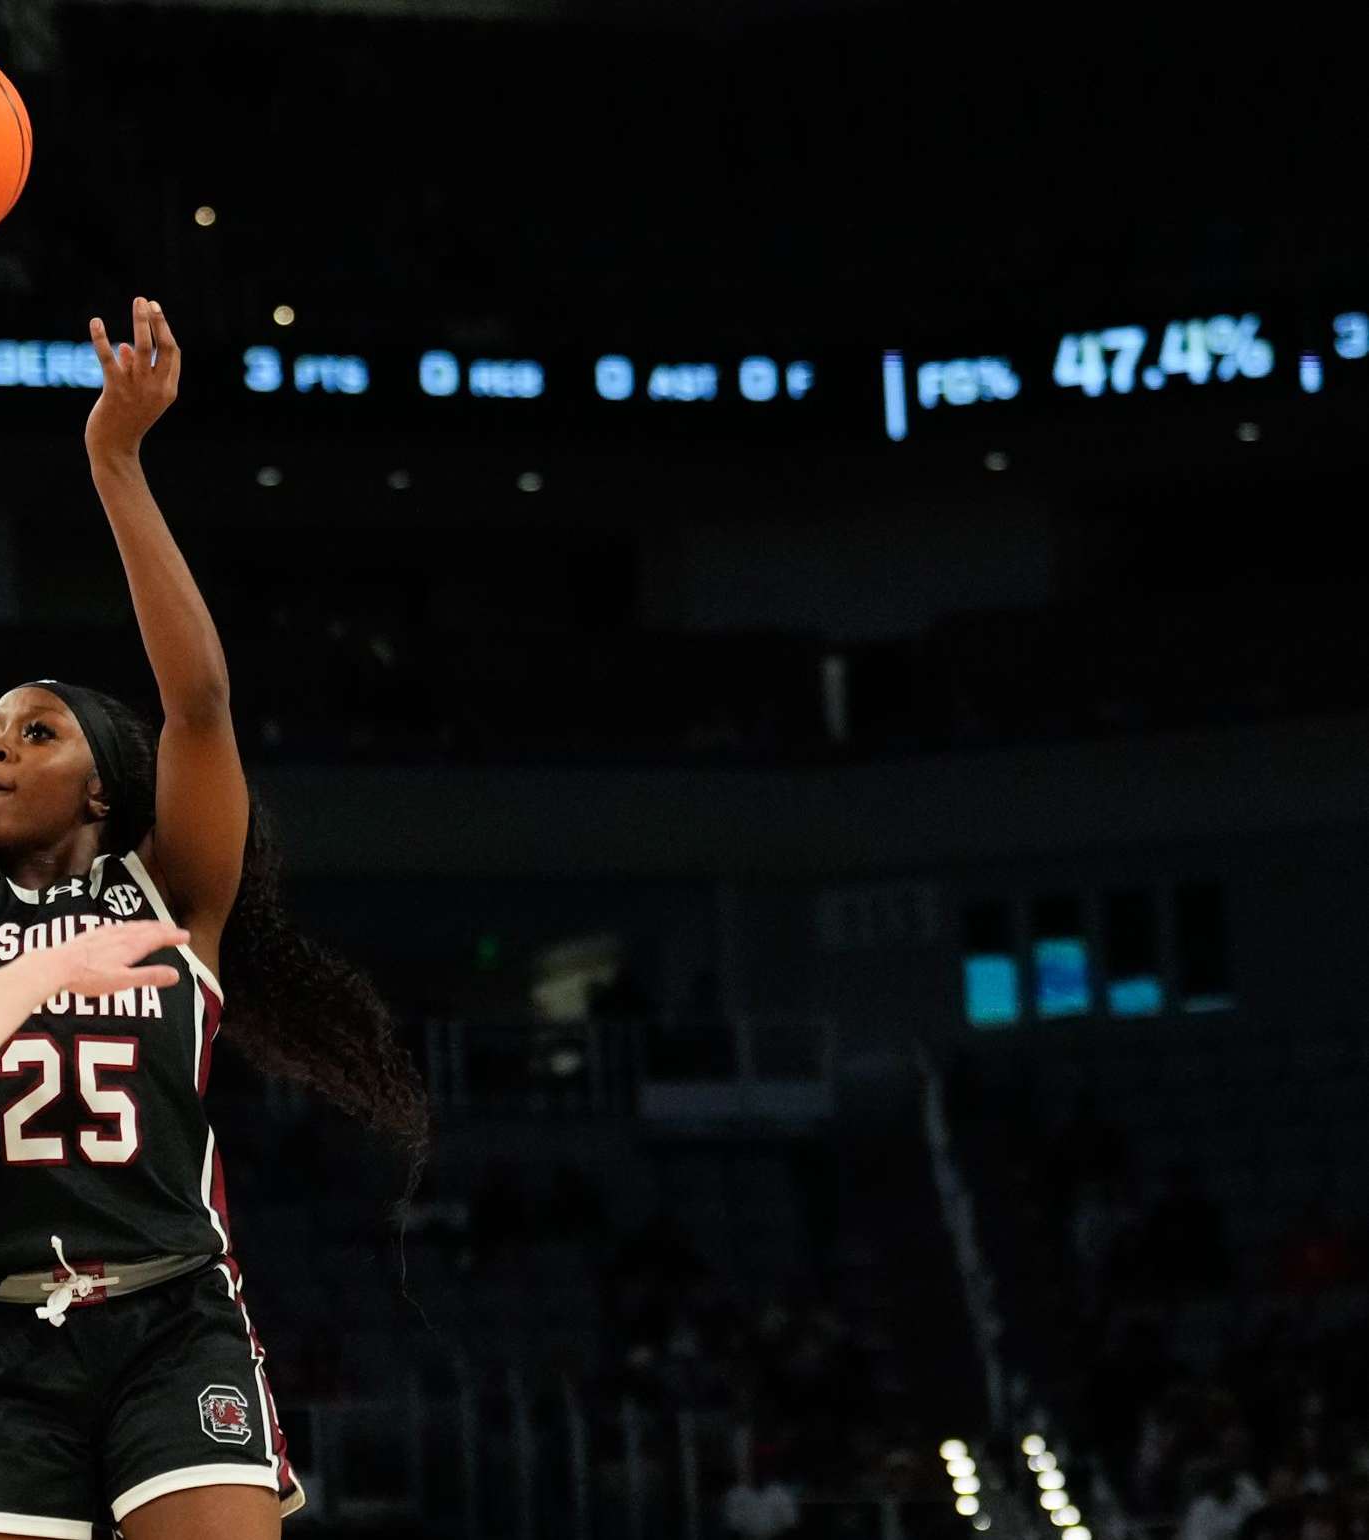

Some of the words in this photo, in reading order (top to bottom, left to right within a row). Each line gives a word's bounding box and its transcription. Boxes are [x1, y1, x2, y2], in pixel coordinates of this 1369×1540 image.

[244, 347, 283, 392] 3
[294, 355, 369, 394] PTS
[419, 350, 460, 396] 0
[595, 354, 634, 400] 0
[738, 356, 778, 401] 0
[918, 357, 1020, 408] FG%
[1053, 314, 1273, 396] 47.4%
[103, 884, 142, 916] SEC
